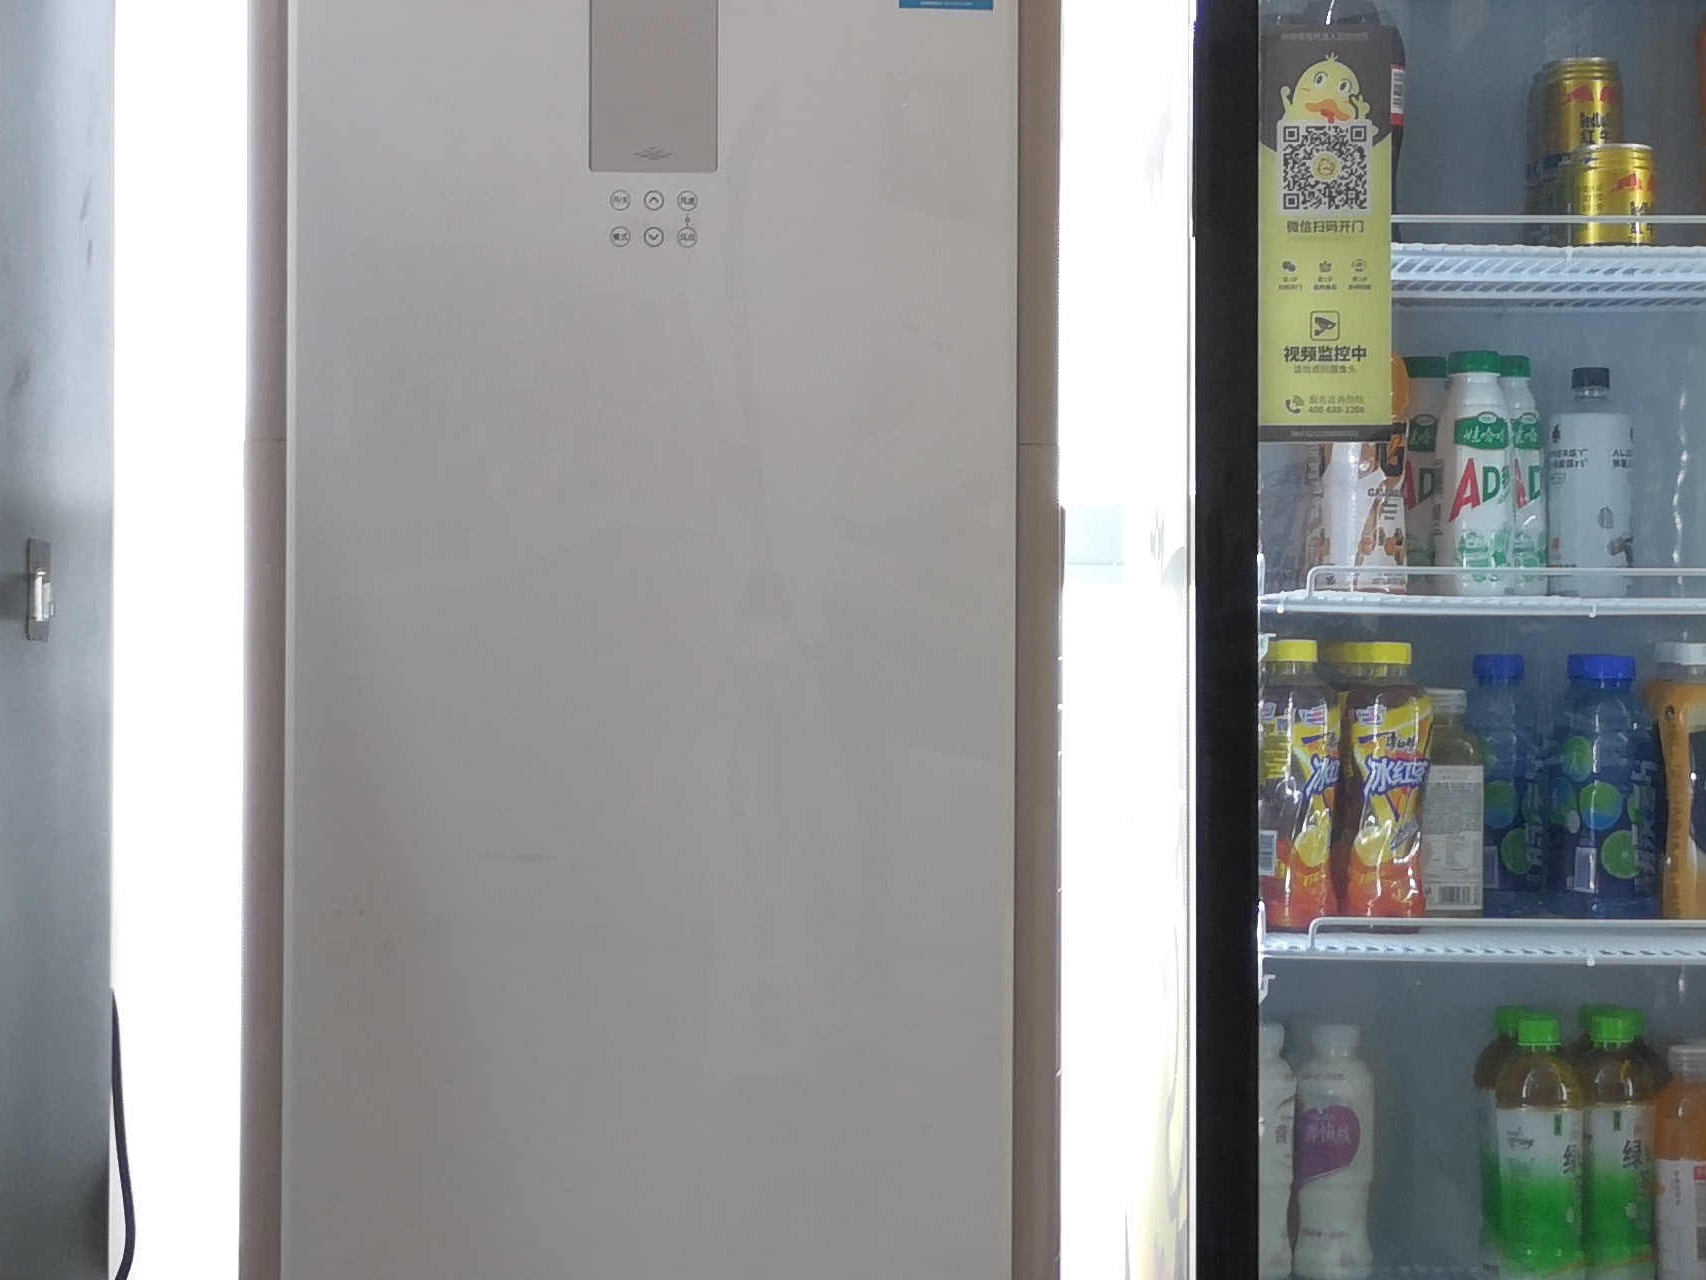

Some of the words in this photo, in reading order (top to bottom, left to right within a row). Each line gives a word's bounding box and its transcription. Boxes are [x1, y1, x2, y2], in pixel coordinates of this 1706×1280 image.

[1286, 220, 1364, 233] 微信扫码开门
[1283, 345, 1367, 362] 视频监控中
